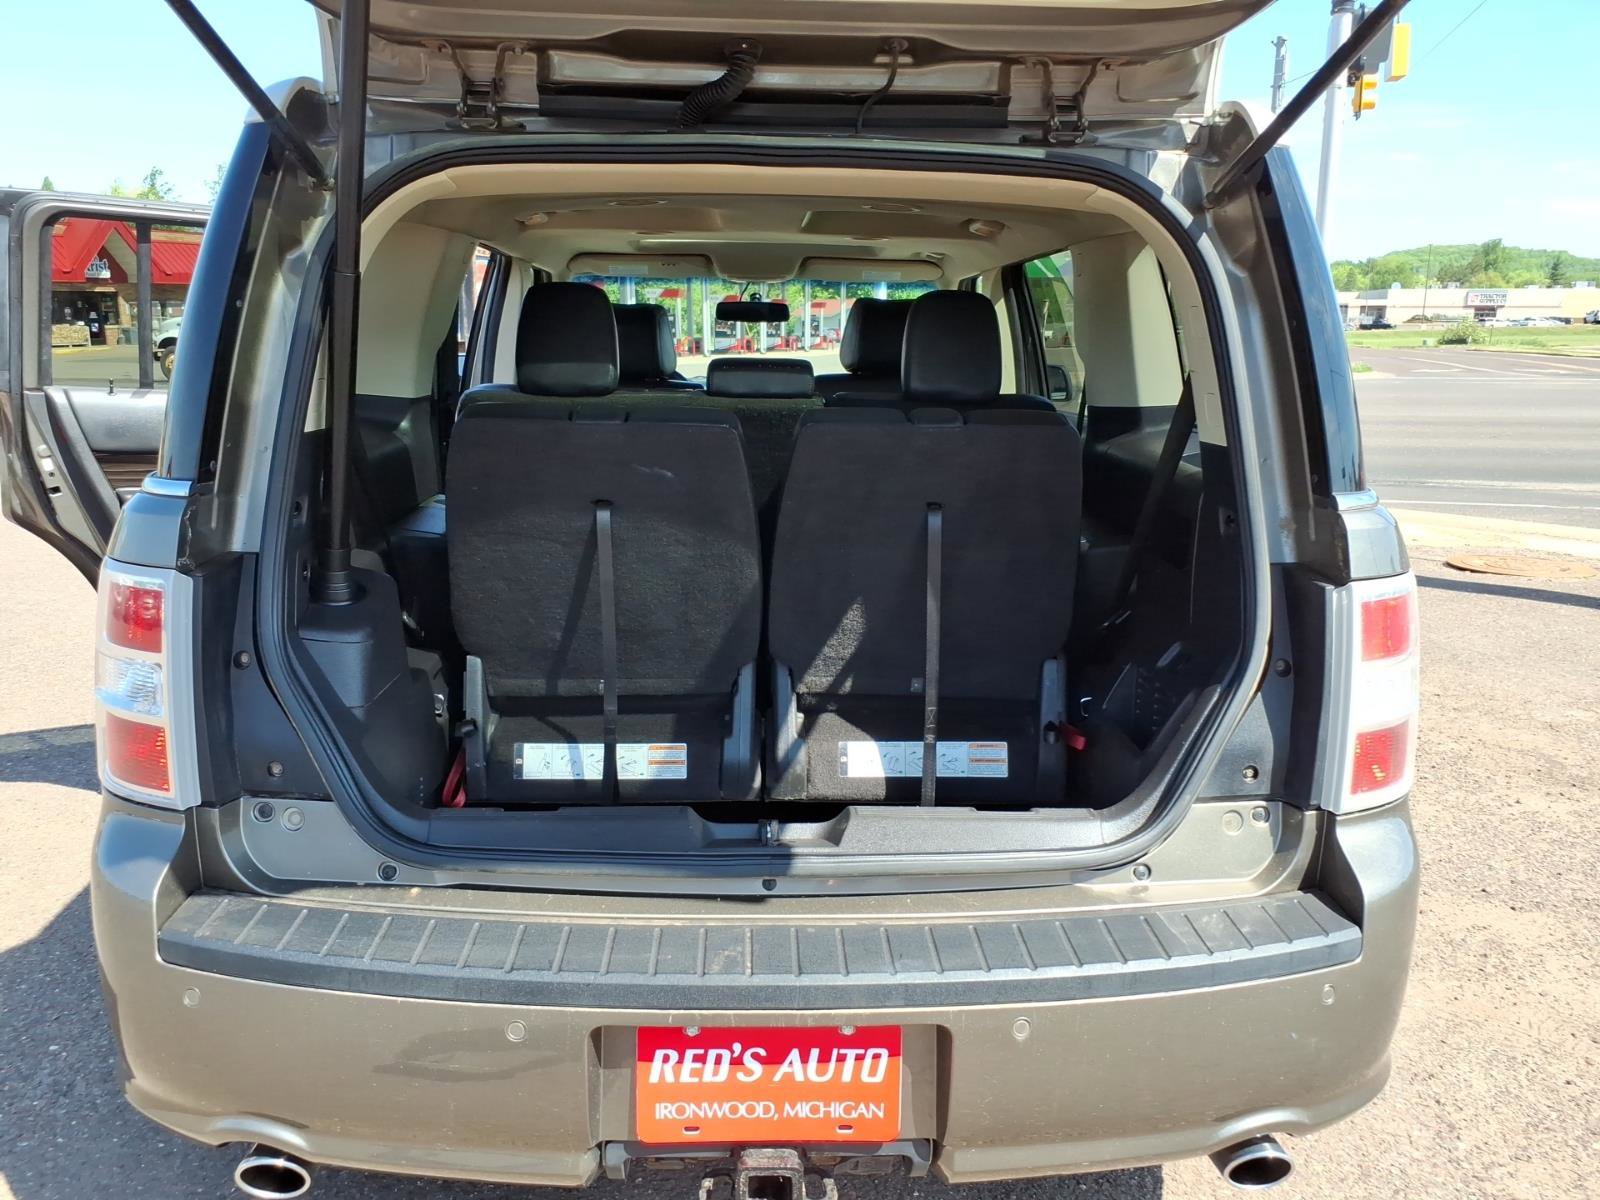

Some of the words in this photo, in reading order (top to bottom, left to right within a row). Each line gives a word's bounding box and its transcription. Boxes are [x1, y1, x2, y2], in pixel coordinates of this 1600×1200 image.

[649, 1042, 767, 1083] RED'S
[772, 1047, 889, 1083] AUTO
[655, 1102, 779, 1120] IRONWOOD,
[783, 1101, 884, 1119] MICHIGAN
